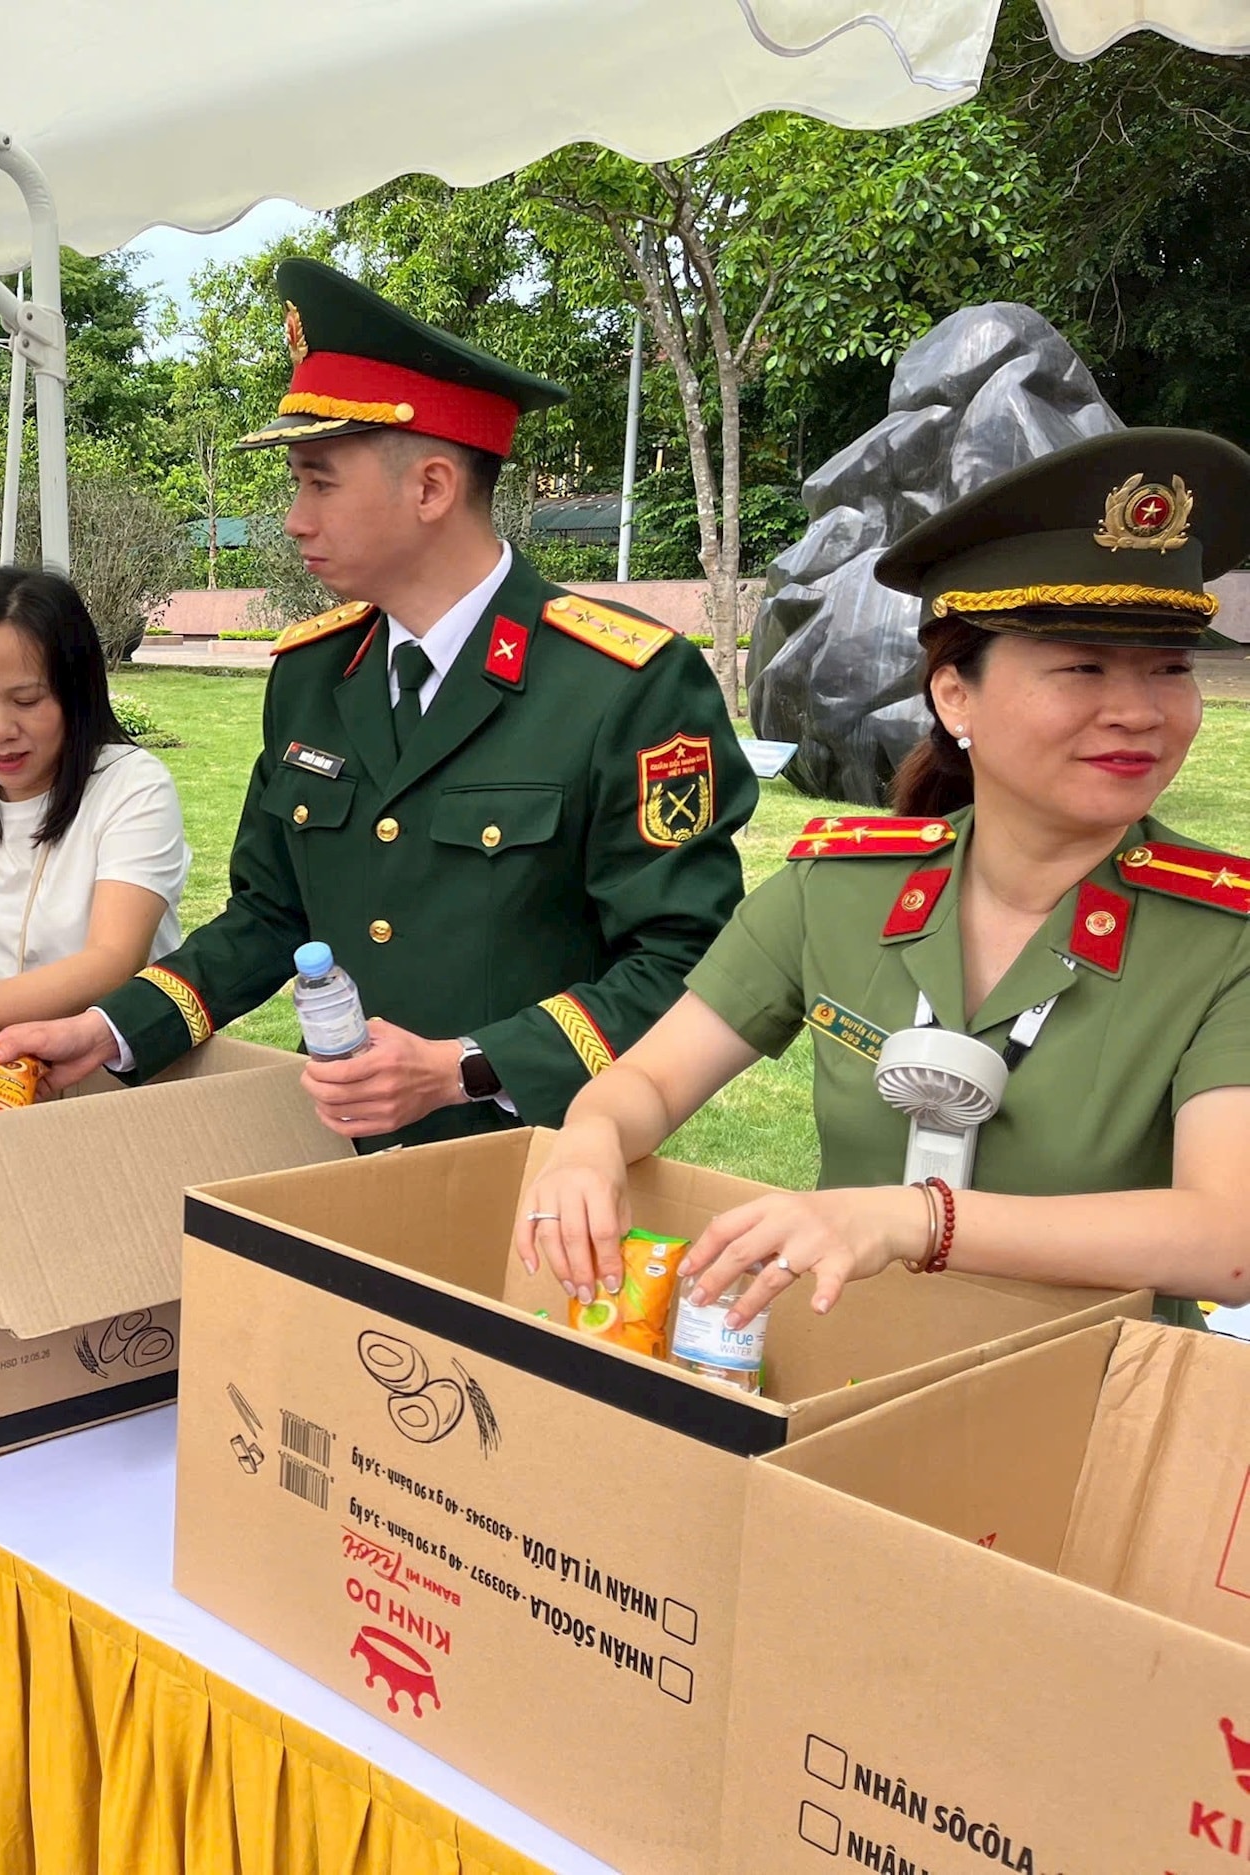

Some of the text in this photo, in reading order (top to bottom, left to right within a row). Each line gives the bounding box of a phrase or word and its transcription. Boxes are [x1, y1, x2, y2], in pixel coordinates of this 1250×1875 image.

[721, 1343, 752, 1357] WATER
[722, 1328, 754, 1346] true
[352, 1446, 364, 1474] kg
[365, 1457, 381, 1477] 3,6
[387, 1468, 413, 1494] bánh
[414, 1482, 427, 1500] 90
[428, 1488, 435, 1501] x
[349, 1496, 363, 1525] kg
[436, 1489, 444, 1505] g
[445, 1497, 459, 1515] 40
[364, 1509, 381, 1529] 3,6
[465, 1507, 513, 1542] 4303945
[387, 1520, 414, 1548] bánh
[415, 1536, 430, 1554] 90
[430, 1543, 438, 1557] x
[439, 1544, 447, 1561] g
[449, 1553, 463, 1572] 40
[522, 1534, 557, 1570] DỨA
[561, 1553, 581, 1583] LÁ
[585, 1559, 602, 1595] VỊ
[422, 1575, 463, 1607] BÁNH
[470, 1565, 521, 1601] 4303937
[605, 1575, 658, 1621] NHÂN
[346, 1577, 453, 1656] KINH DO
[530, 1595, 596, 1648] SÔCÔLA
[600, 1631, 654, 1680] NHÂN
[853, 1763, 1034, 1875] NHÂN SÔCÔLA
[1189, 1800, 1250, 1862] KI
[847, 1830, 916, 1875] NHÂN
